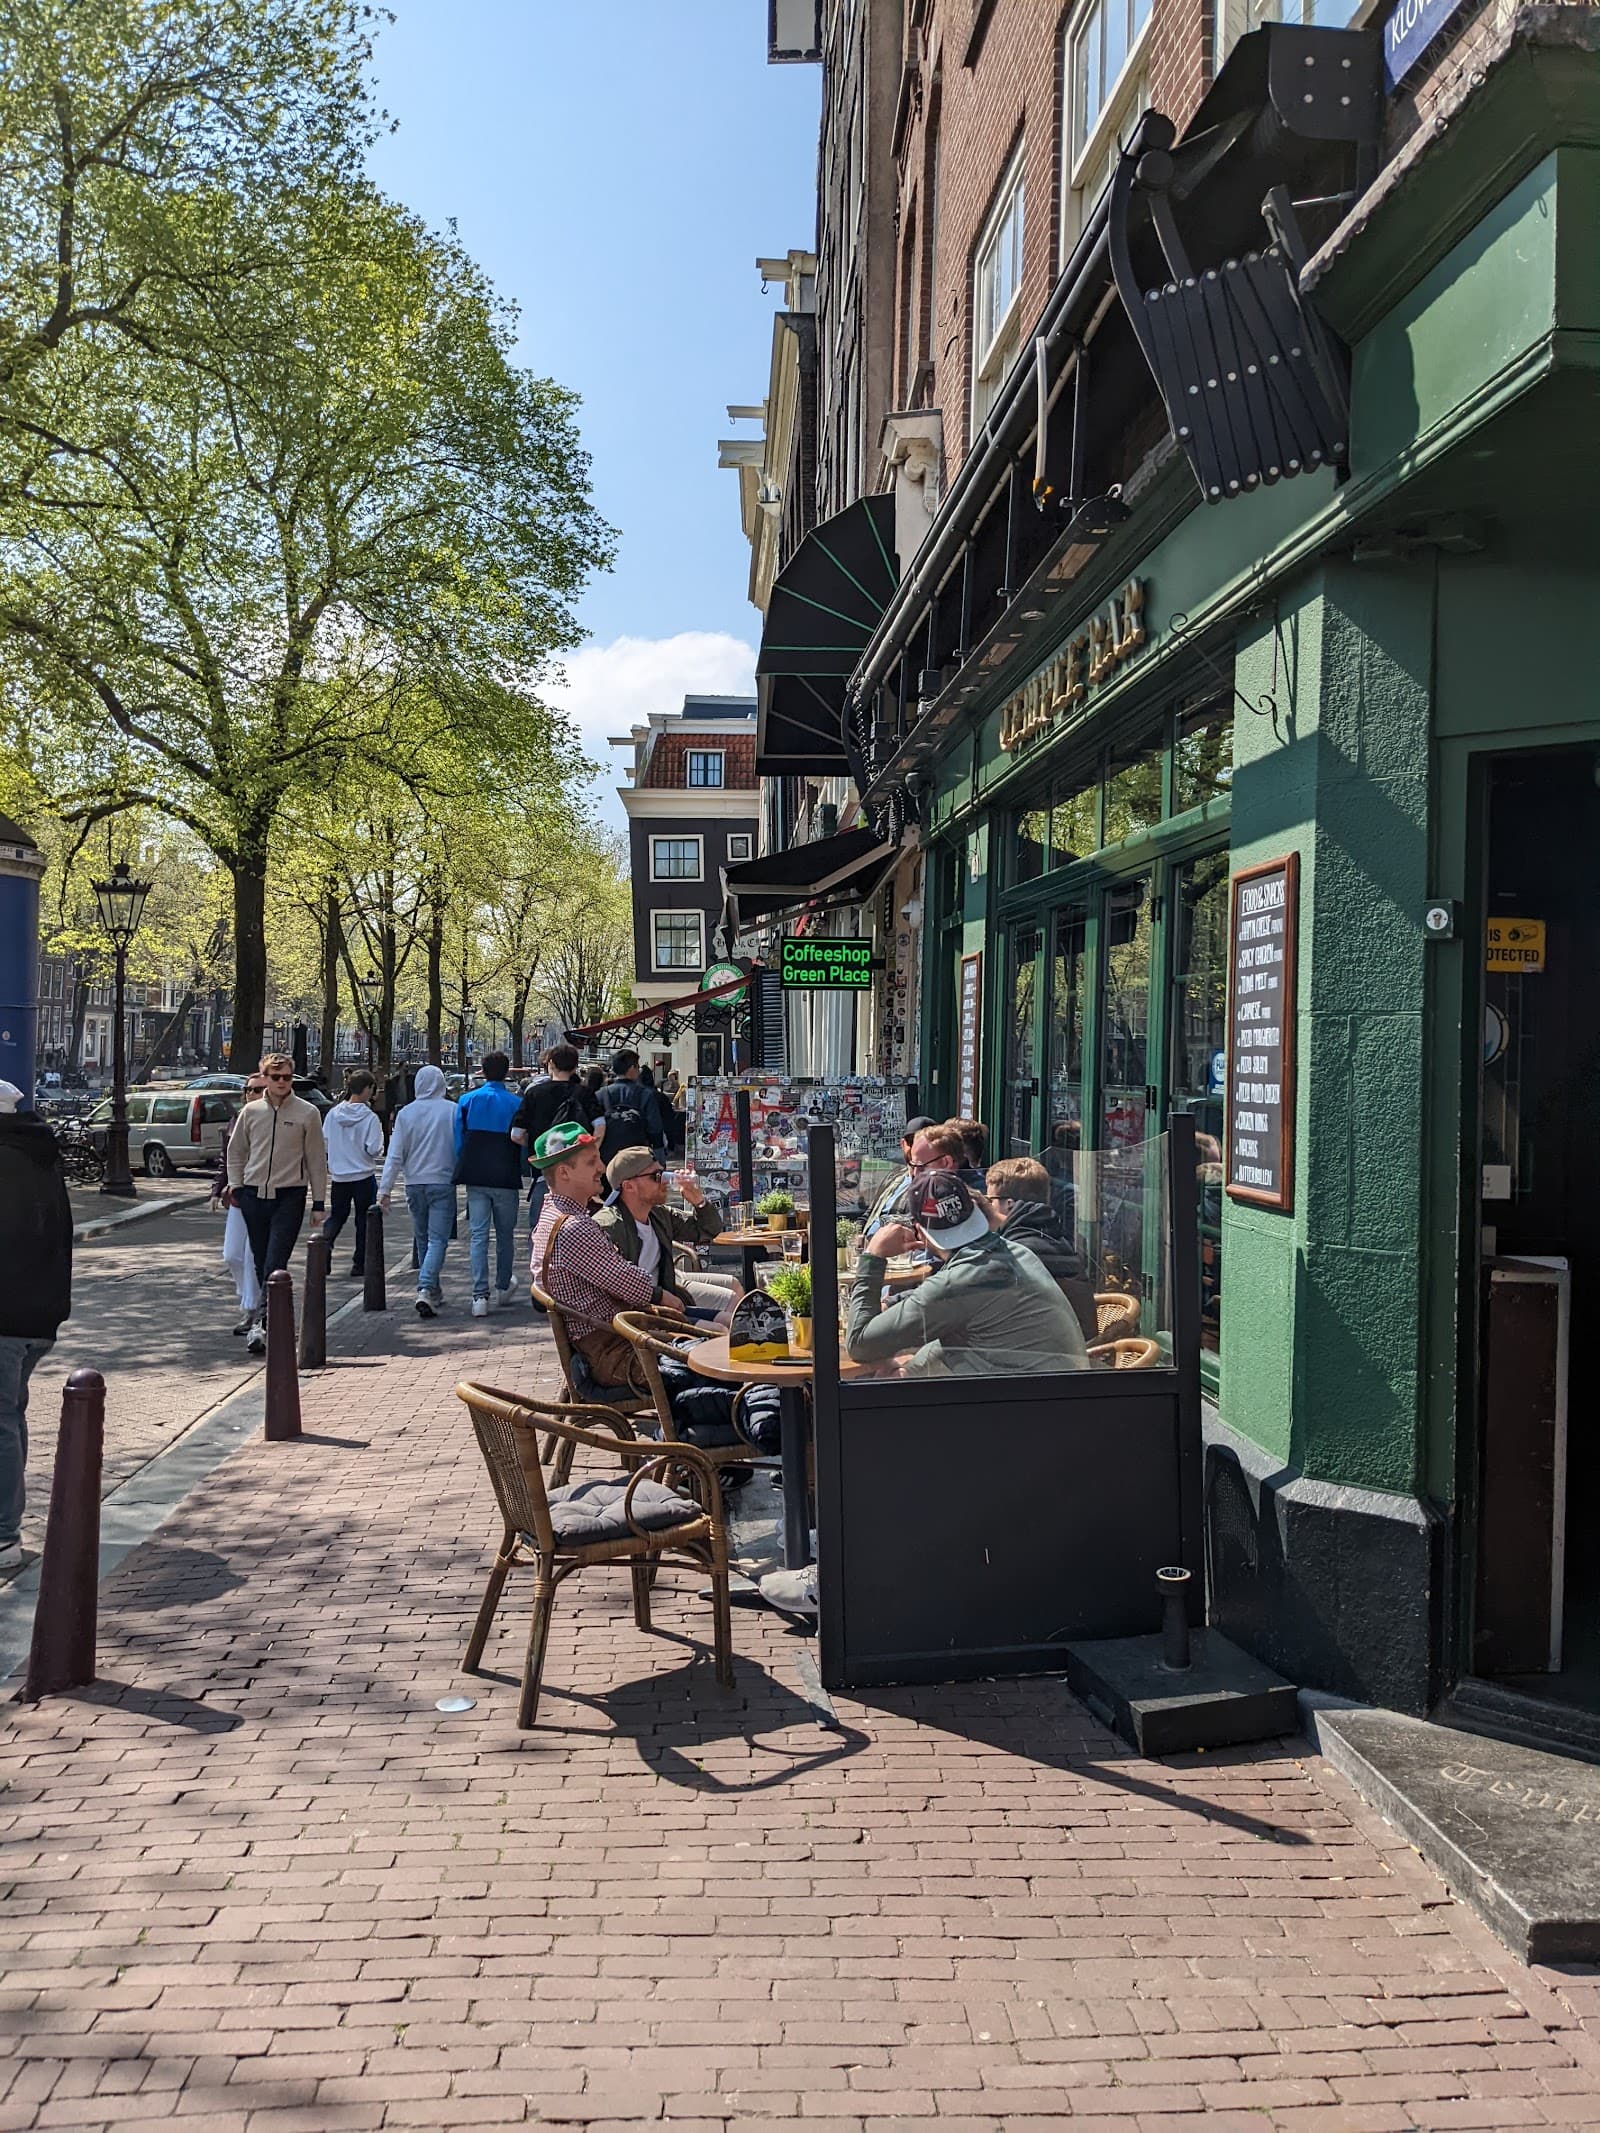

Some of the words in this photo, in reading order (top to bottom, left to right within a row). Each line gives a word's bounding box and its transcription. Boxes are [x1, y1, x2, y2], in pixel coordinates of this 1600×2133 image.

[1392, 0, 1432, 52] KLO
[1489, 928, 1501, 941] IS
[783, 944, 871, 966] Coffeeshop
[783, 965, 825, 981] Green
[830, 966, 870, 982] Place
[224, 1019, 233, 1032] P
[935, 1196, 962, 1219] NETS
